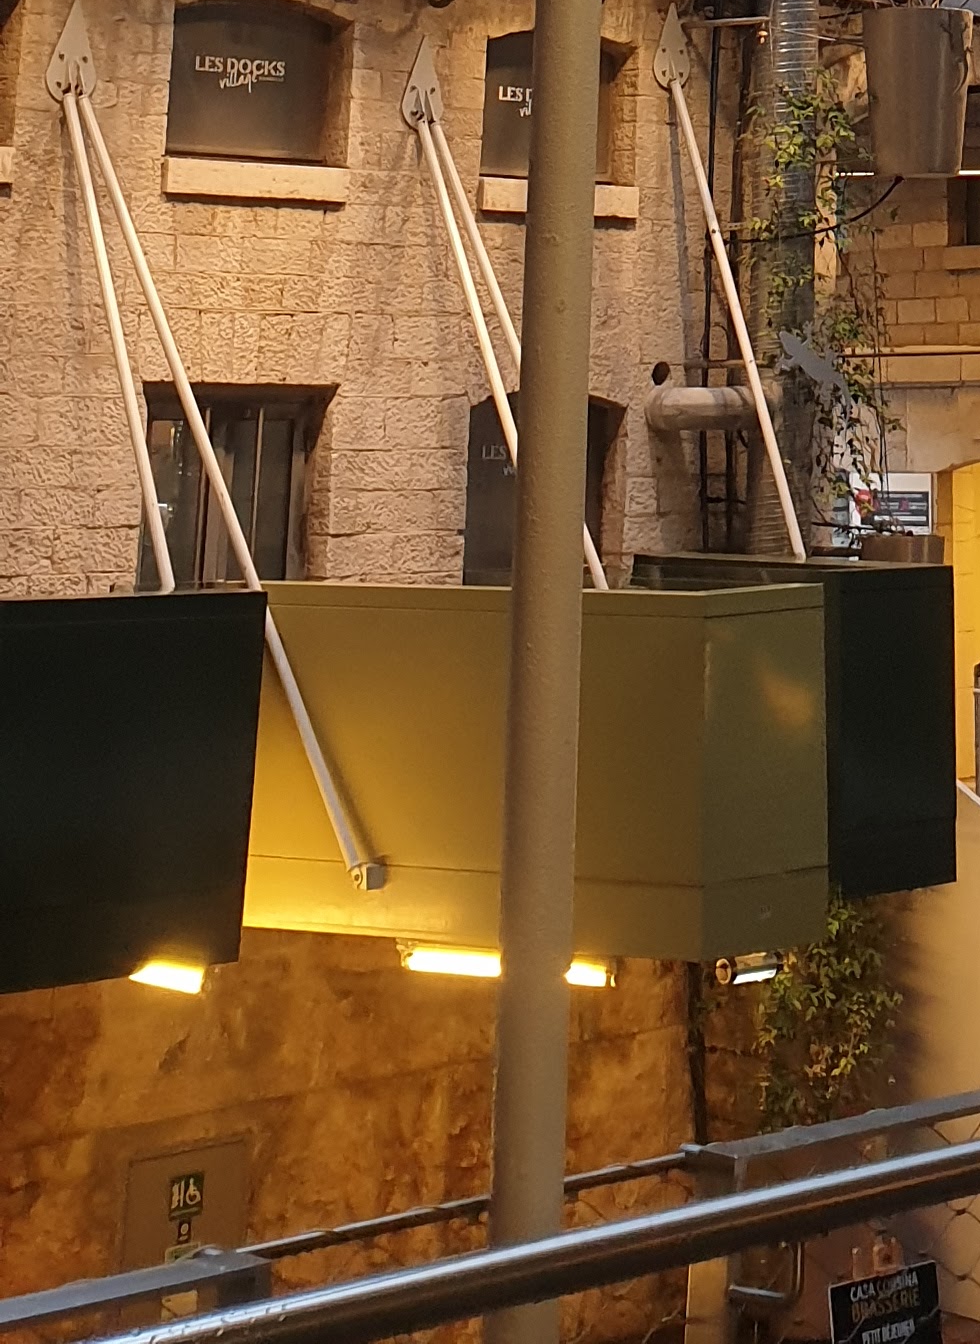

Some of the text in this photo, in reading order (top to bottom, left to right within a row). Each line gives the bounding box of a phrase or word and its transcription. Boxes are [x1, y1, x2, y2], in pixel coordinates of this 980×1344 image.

[195, 56, 285, 76] LES DOCKS
[219, 70, 257, 93] village
[499, 86, 523, 101] LES
[482, 445, 506, 460] LES
